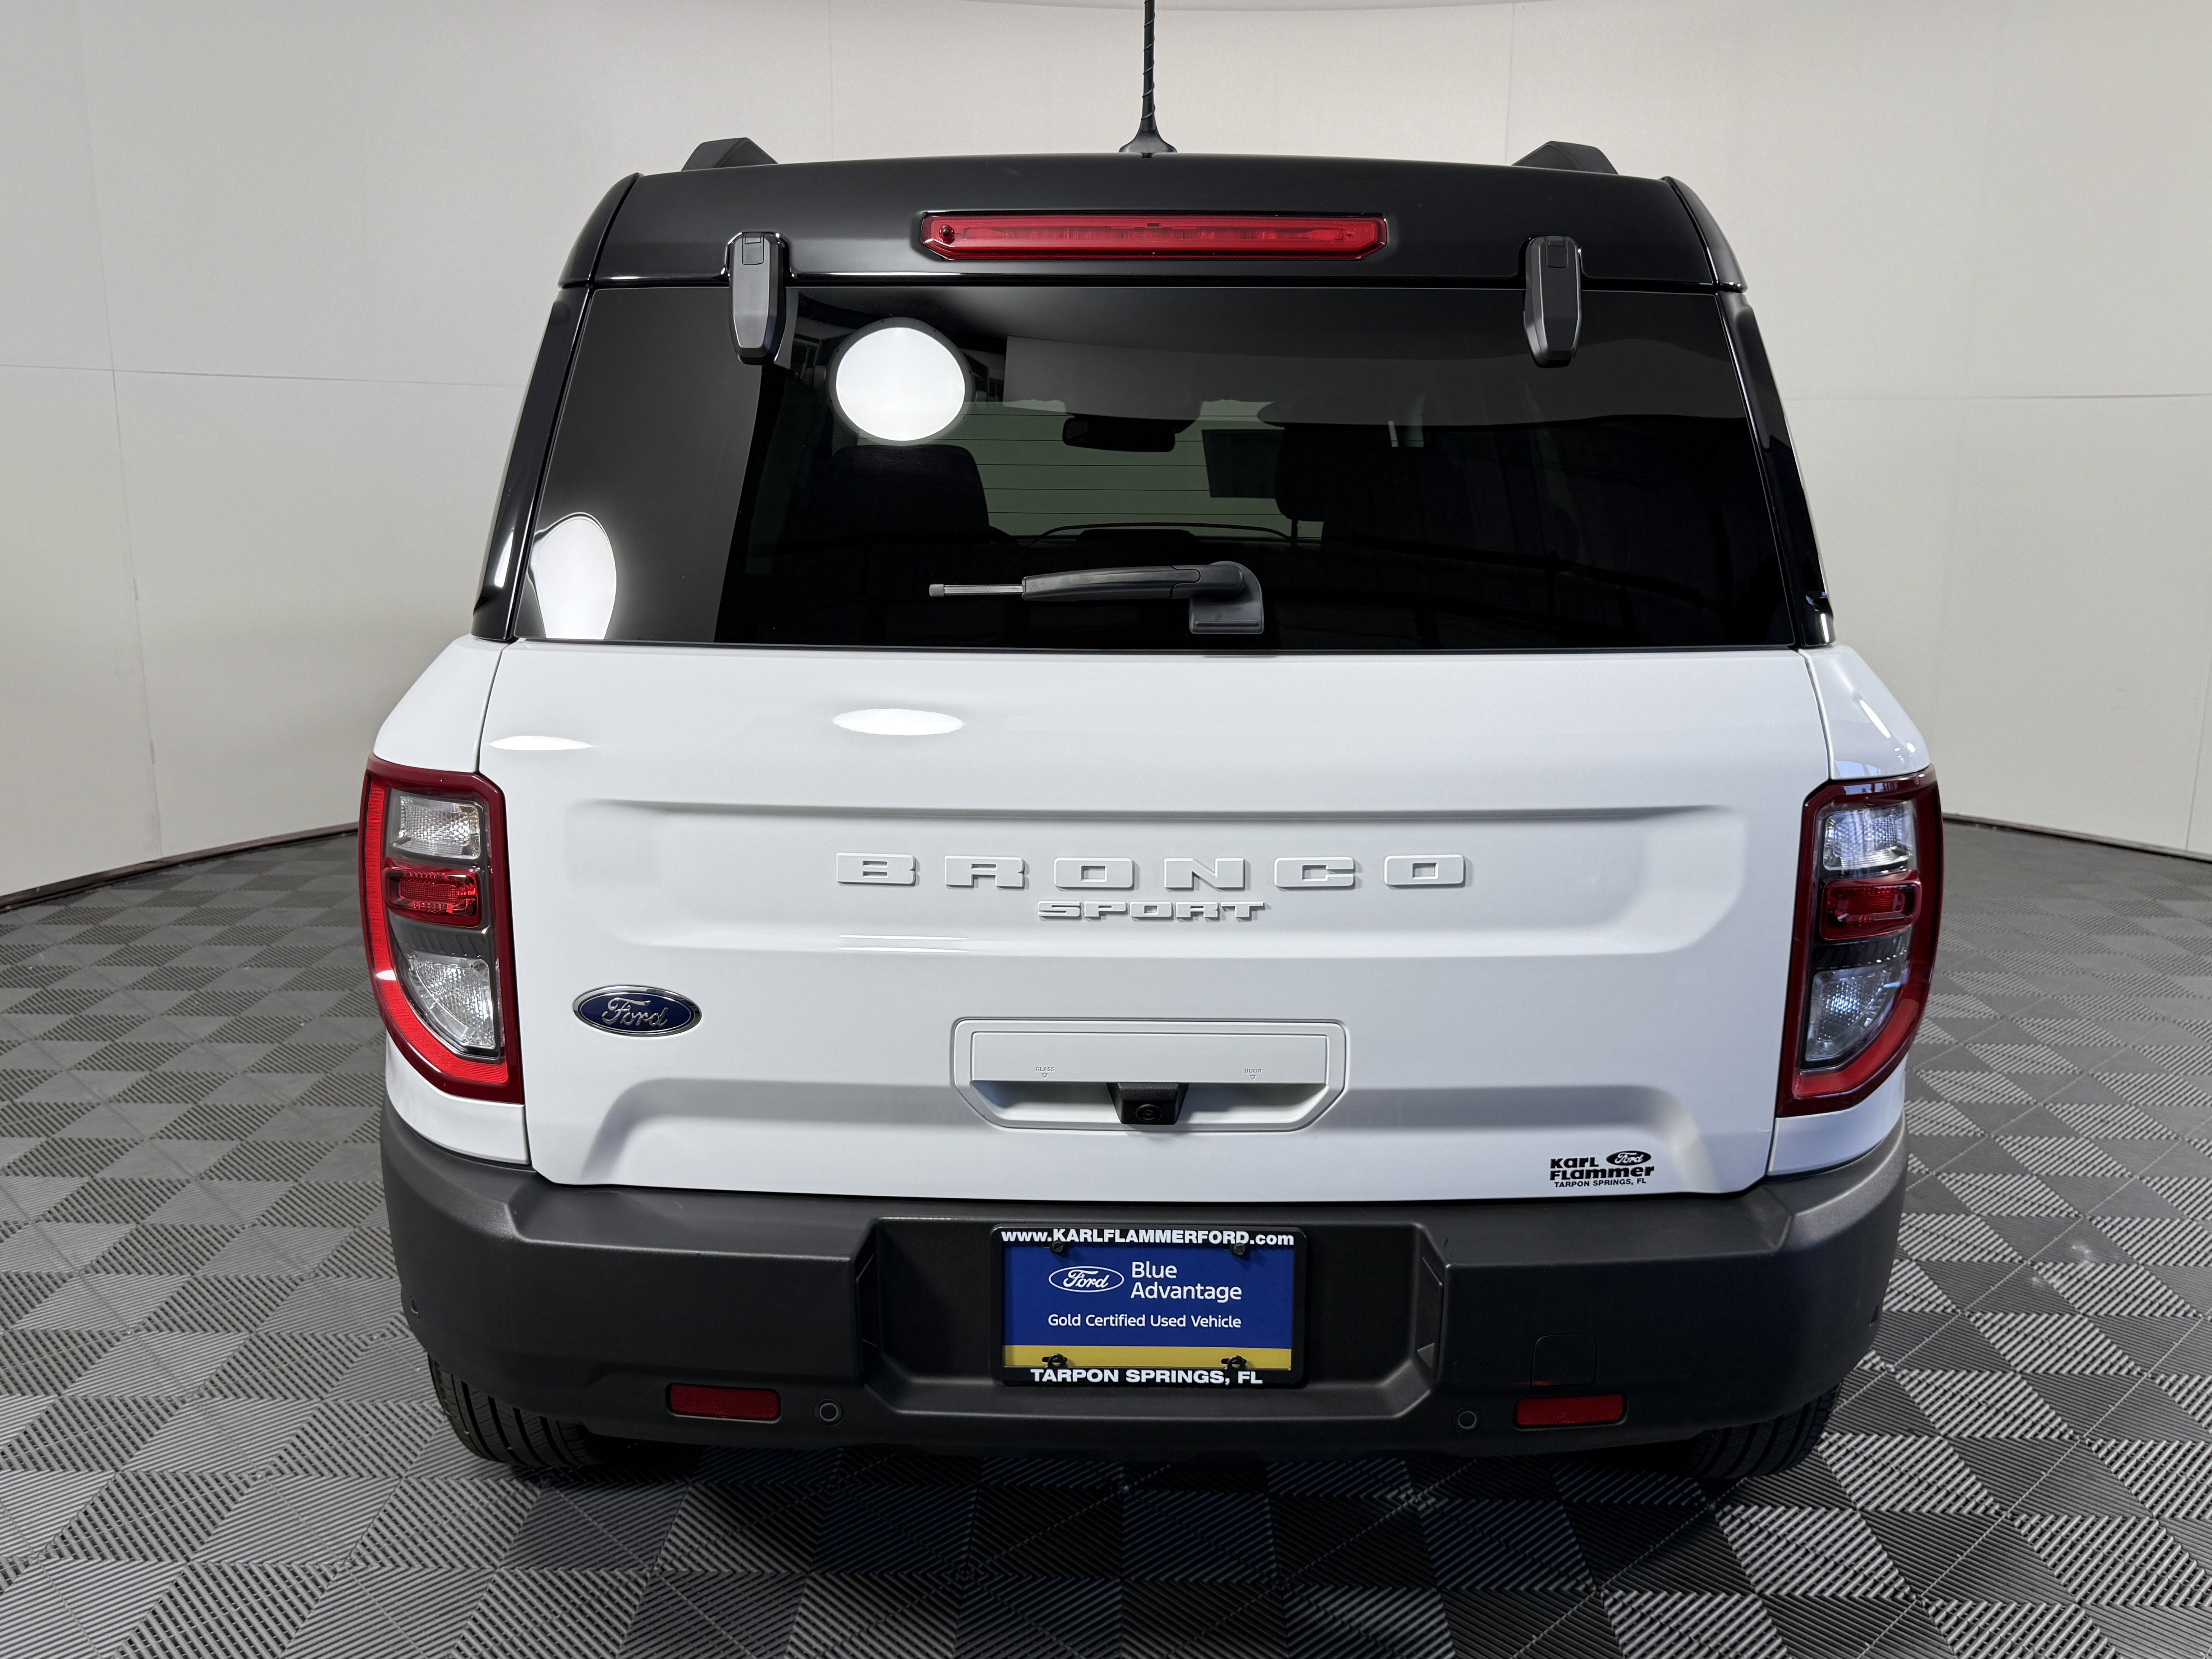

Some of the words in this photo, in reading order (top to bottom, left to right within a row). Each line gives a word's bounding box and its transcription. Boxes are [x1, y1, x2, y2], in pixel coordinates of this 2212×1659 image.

[836, 852, 1466, 889] BRONCO
[1037, 901, 1264, 918] SPORT
[601, 997, 669, 1026] Ford
[1614, 1152, 1644, 1164] Ford
[1001, 1228, 1294, 1245] www.KARLFLAMMERFORD.com
[1132, 1261, 1178, 1278] Blue
[1063, 1269, 1110, 1288] Ford
[1130, 1281, 1242, 1304] Advantage
[1048, 1314, 1081, 1326] Gold
[1085, 1314, 1146, 1327] Certified
[1150, 1314, 1187, 1327] Used
[1190, 1315, 1242, 1328] Vehicle
[1030, 1369, 1119, 1382] TARPON
[1125, 1369, 1230, 1385] SPRINGS,
[1238, 1371, 1263, 1384] FL
